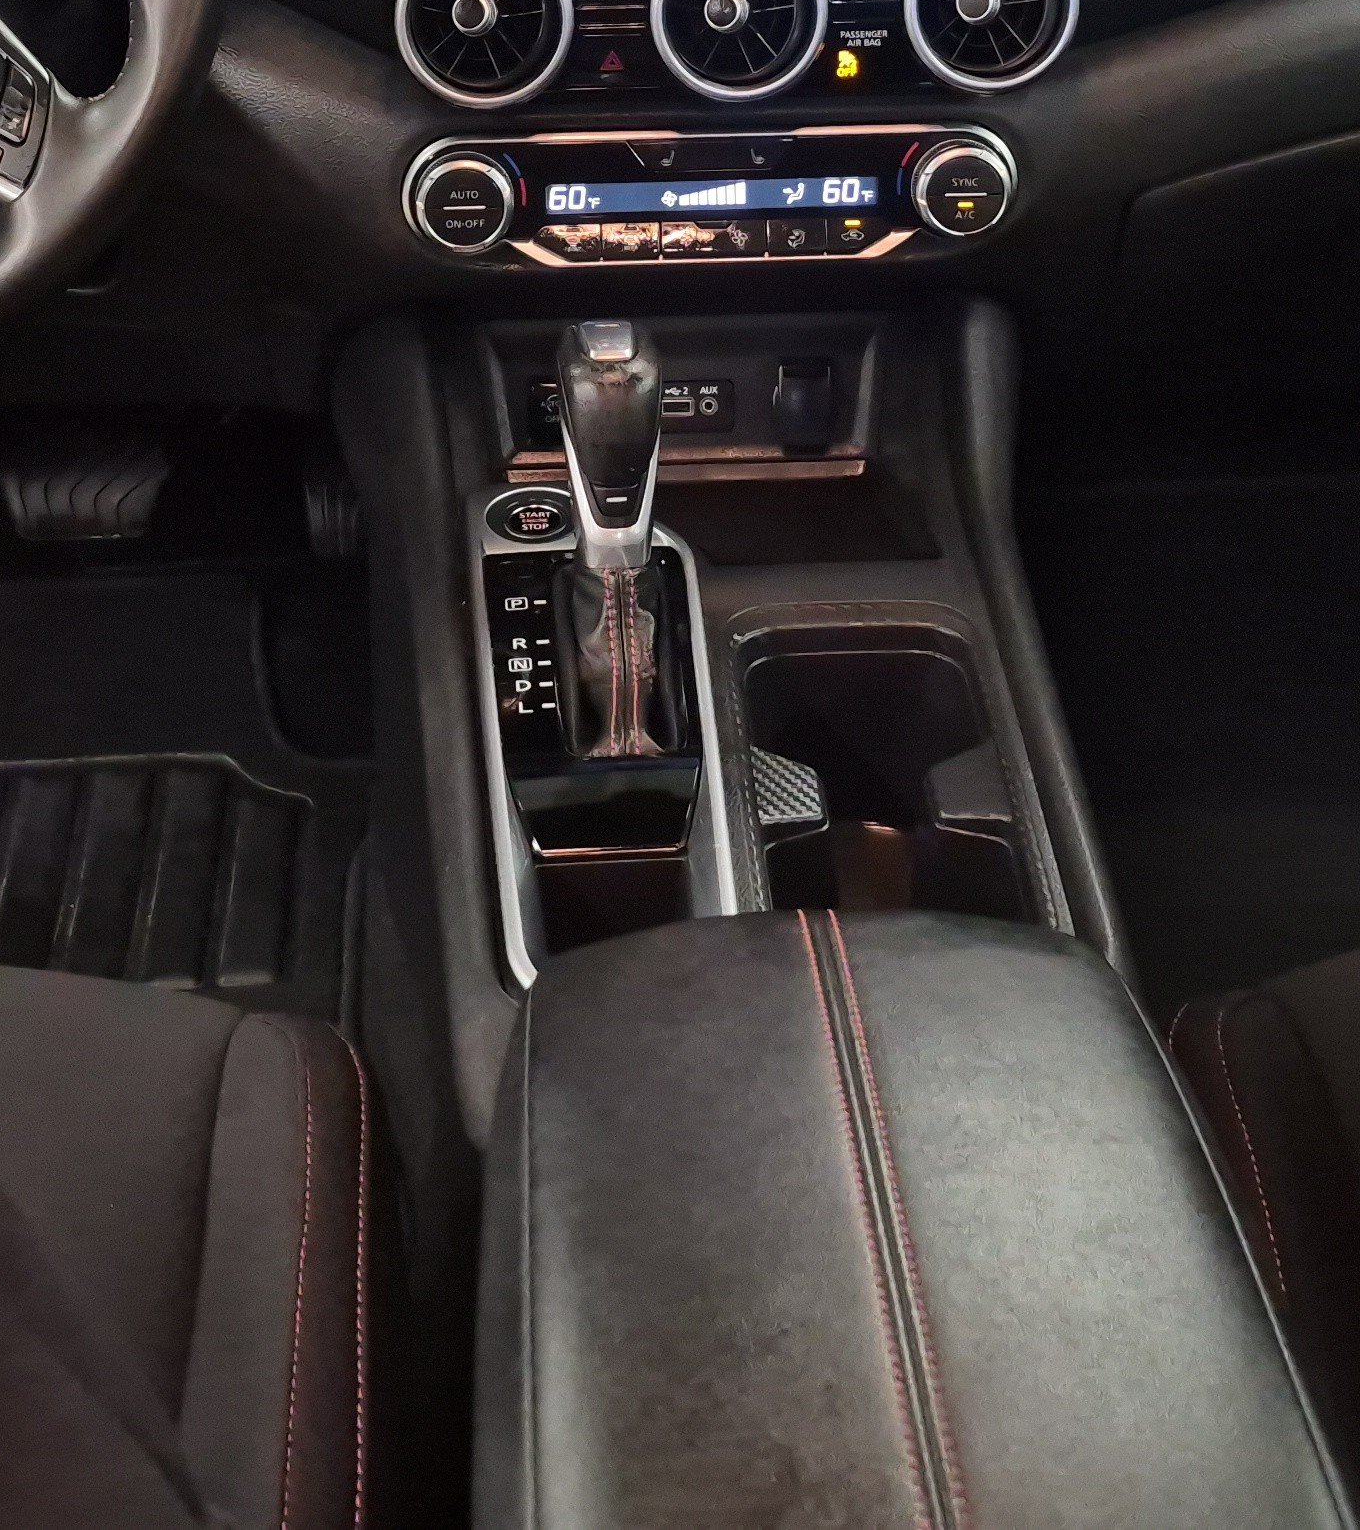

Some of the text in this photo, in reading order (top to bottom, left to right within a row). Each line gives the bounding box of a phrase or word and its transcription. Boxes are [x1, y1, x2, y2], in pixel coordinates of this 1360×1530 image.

[840, 30, 888, 39] PASSENGER
[846, 38, 882, 47] AIR BAG
[951, 177, 979, 187] SYNC
[450, 190, 479, 200] AUTO
[955, 210, 976, 220] A/C
[699, 386, 719, 395] AUX
[519, 511, 551, 519] START
[521, 523, 550, 531] STOP
[510, 599, 523, 609] P
[512, 637, 527, 650] R
[513, 659, 528, 670] N
[515, 679, 532, 692] D
[518, 701, 534, 714] L
